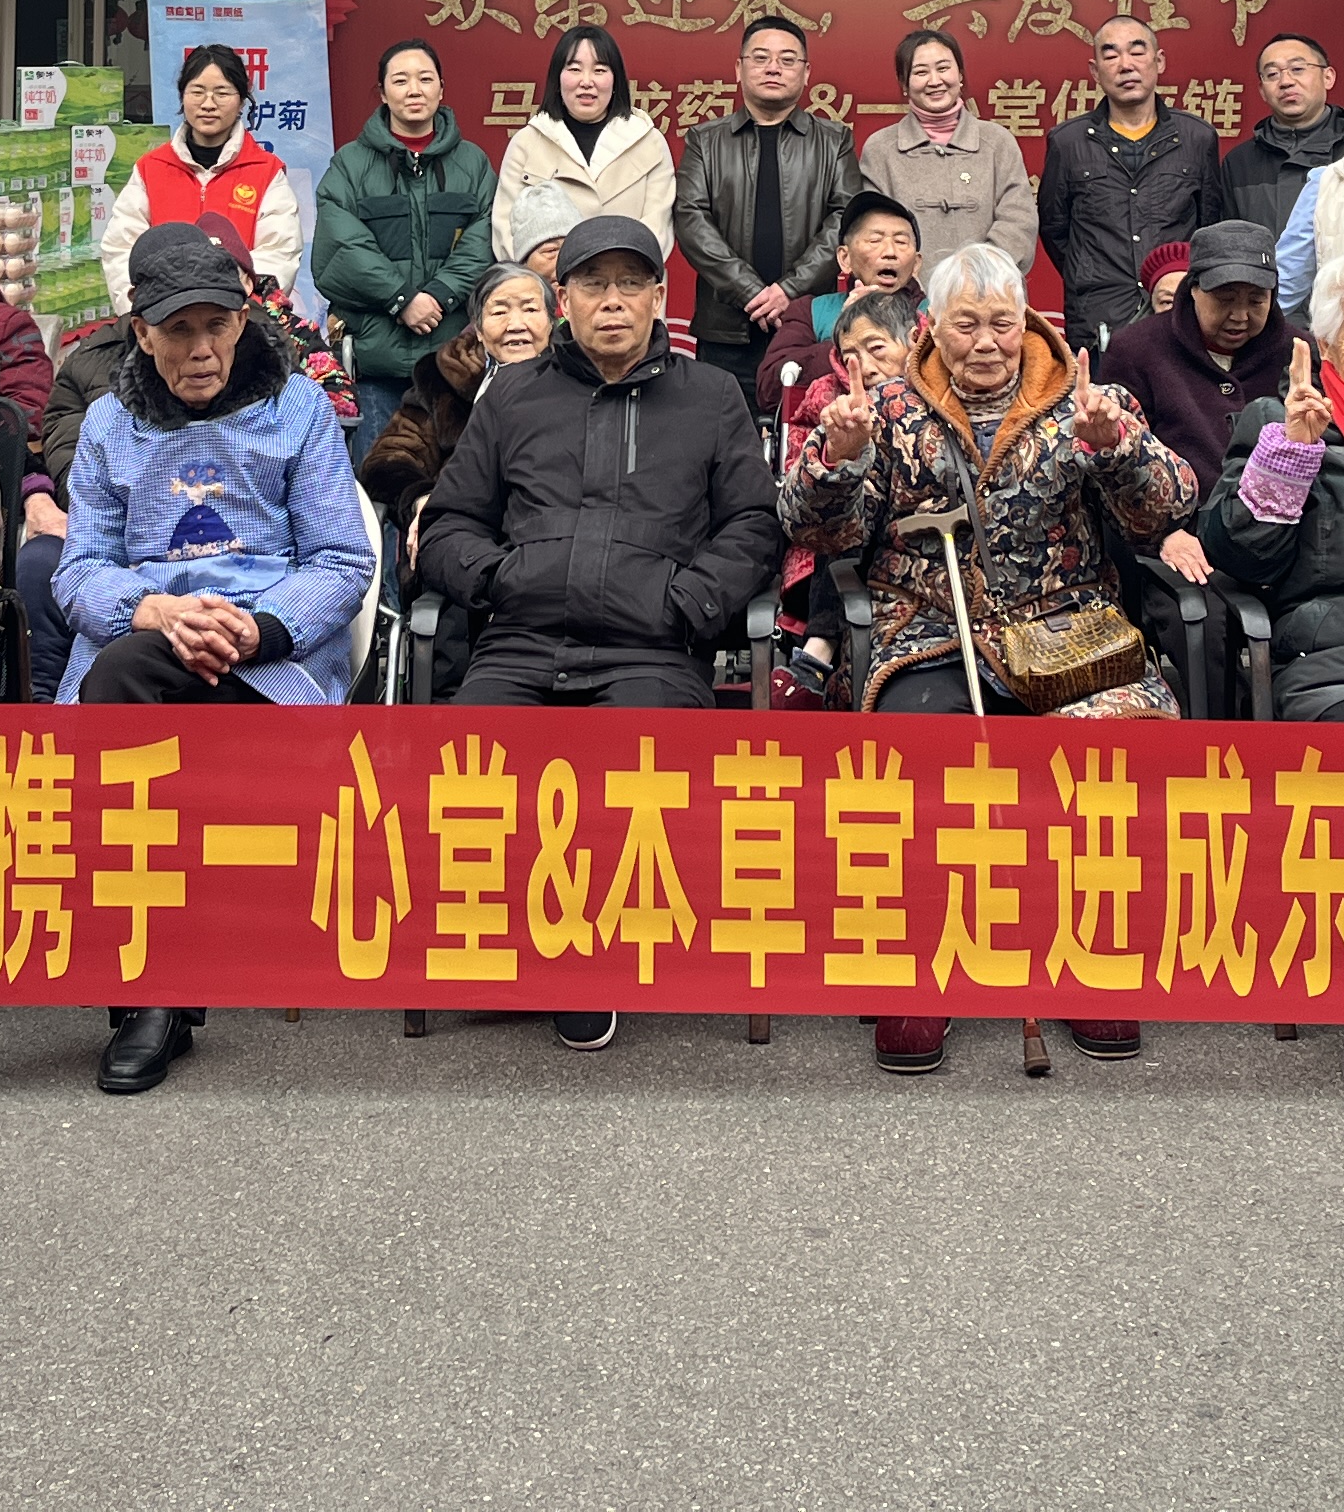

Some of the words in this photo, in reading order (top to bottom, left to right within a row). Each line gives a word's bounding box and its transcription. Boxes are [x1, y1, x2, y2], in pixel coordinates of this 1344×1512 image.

[24, 89, 57, 105] 纯牛奶
[74, 148, 106, 162] 纯牛奶
